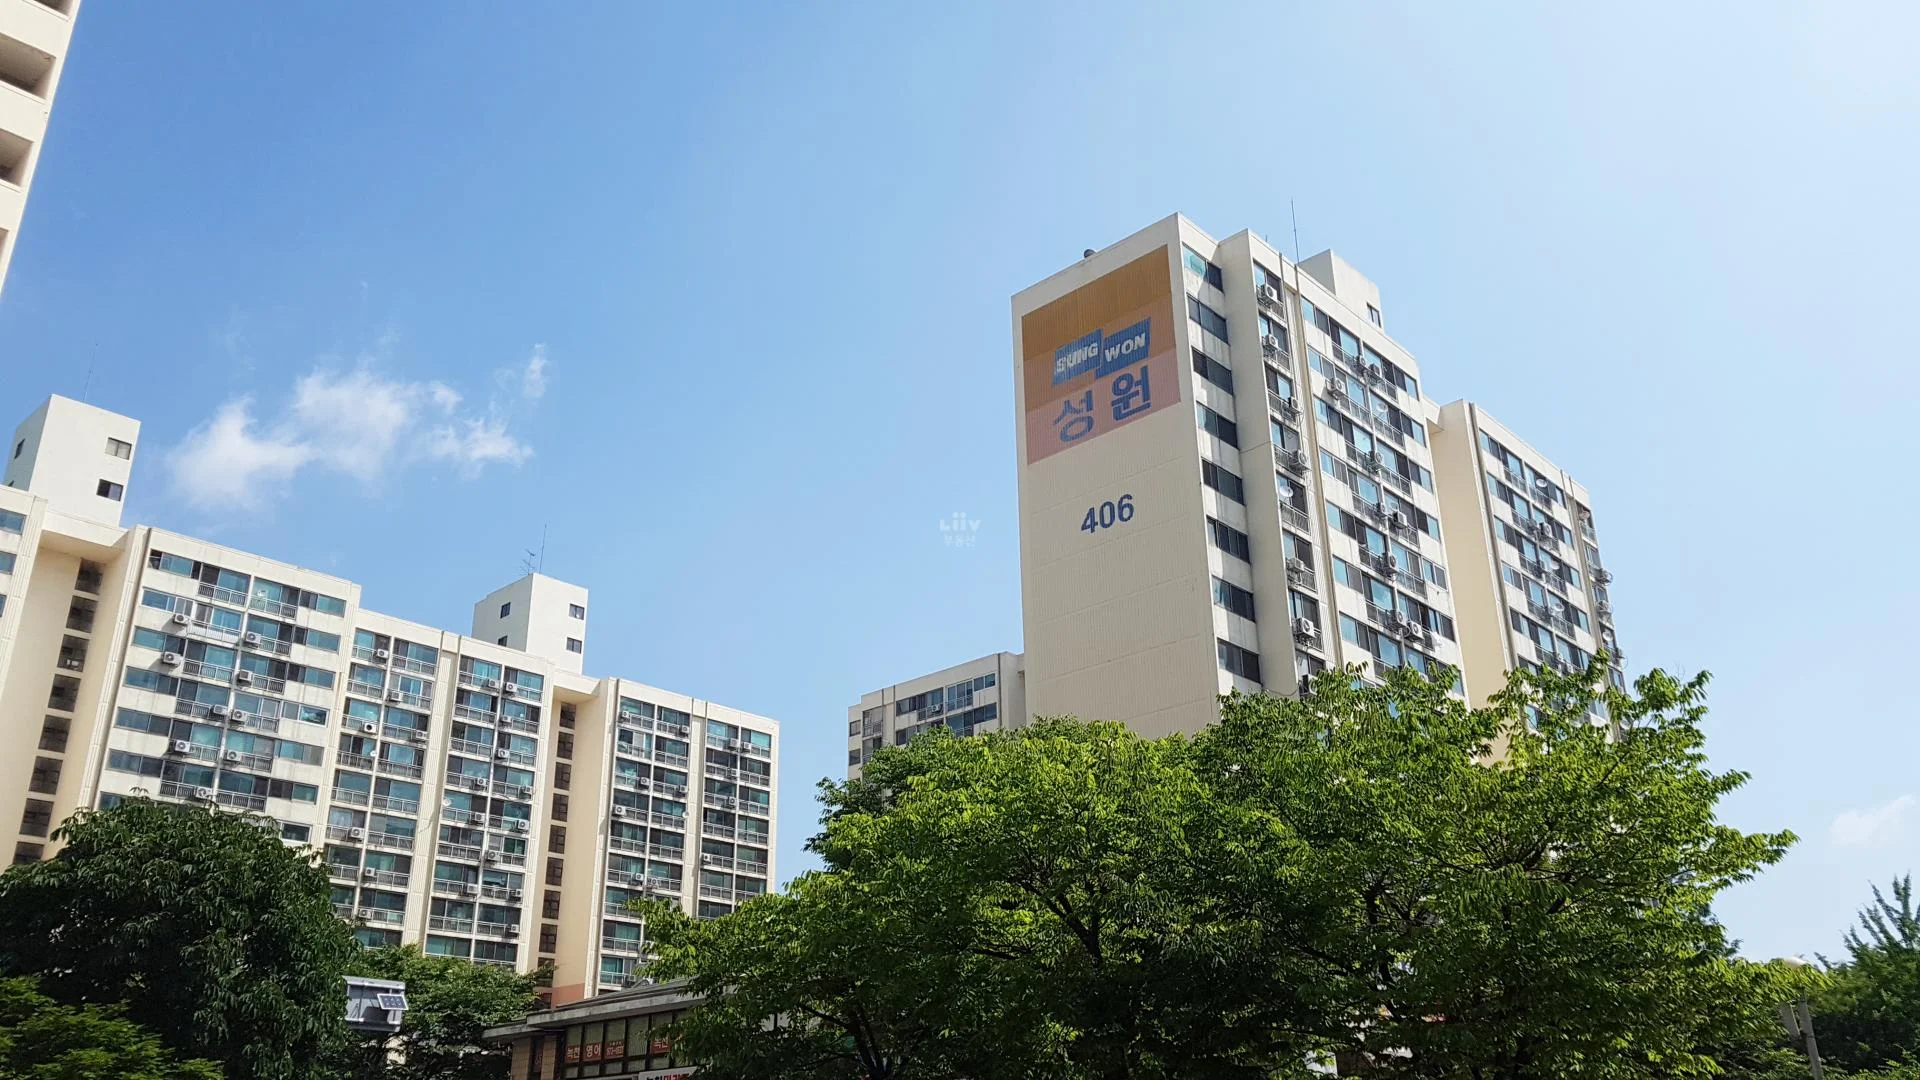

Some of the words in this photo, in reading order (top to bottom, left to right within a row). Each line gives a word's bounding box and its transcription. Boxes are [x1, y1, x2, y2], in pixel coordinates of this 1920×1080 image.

[1056, 342, 1099, 373] SUNG
[1105, 332, 1146, 362] WON
[1054, 365, 1151, 442] 성원
[1081, 493, 1134, 534] 406
